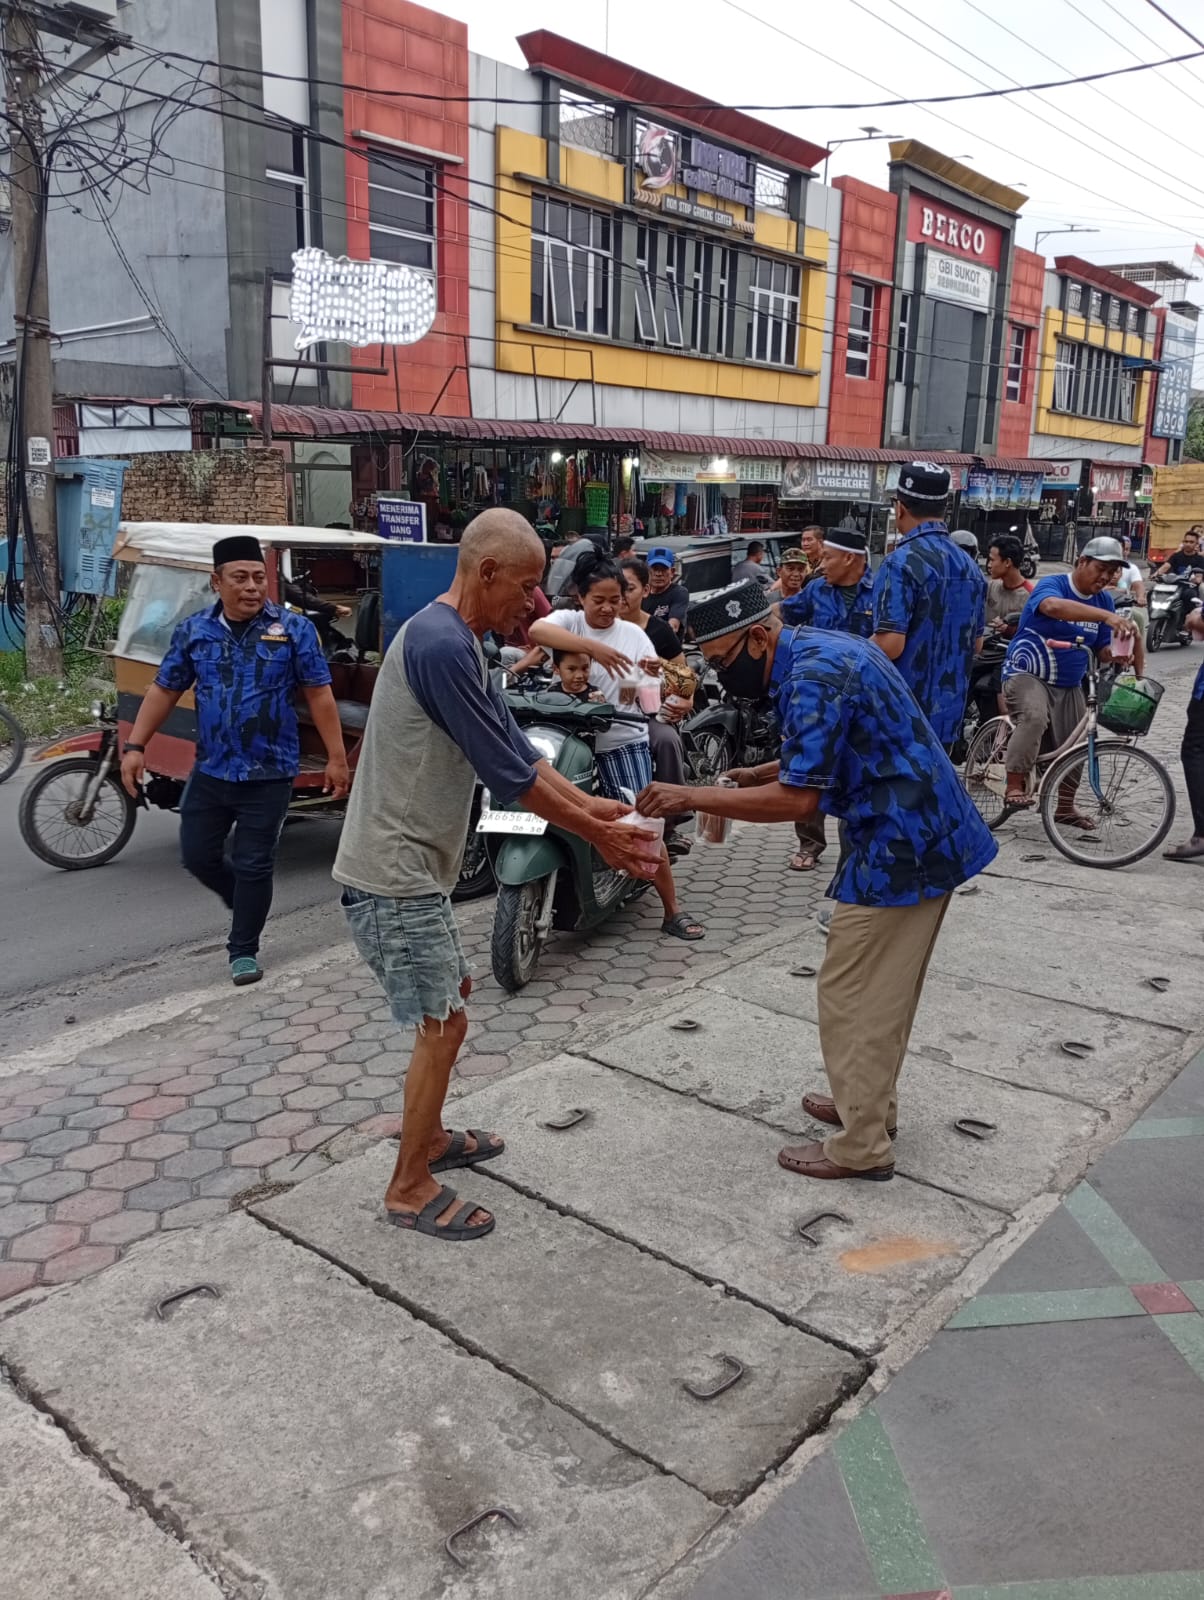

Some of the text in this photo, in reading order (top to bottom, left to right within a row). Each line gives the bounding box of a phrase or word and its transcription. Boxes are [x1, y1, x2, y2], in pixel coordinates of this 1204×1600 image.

[678, 201, 692, 214] STOP
[921, 207, 985, 254] BERCO
[938, 259, 981, 285] GBI SUKOT
[816, 459, 869, 479] DAFIRA
[817, 477, 870, 489] CYBERCAFE
[379, 503, 419, 515] MENERIMA
[381, 514, 420, 525] TRANSFER
[390, 525, 412, 535] UANG
